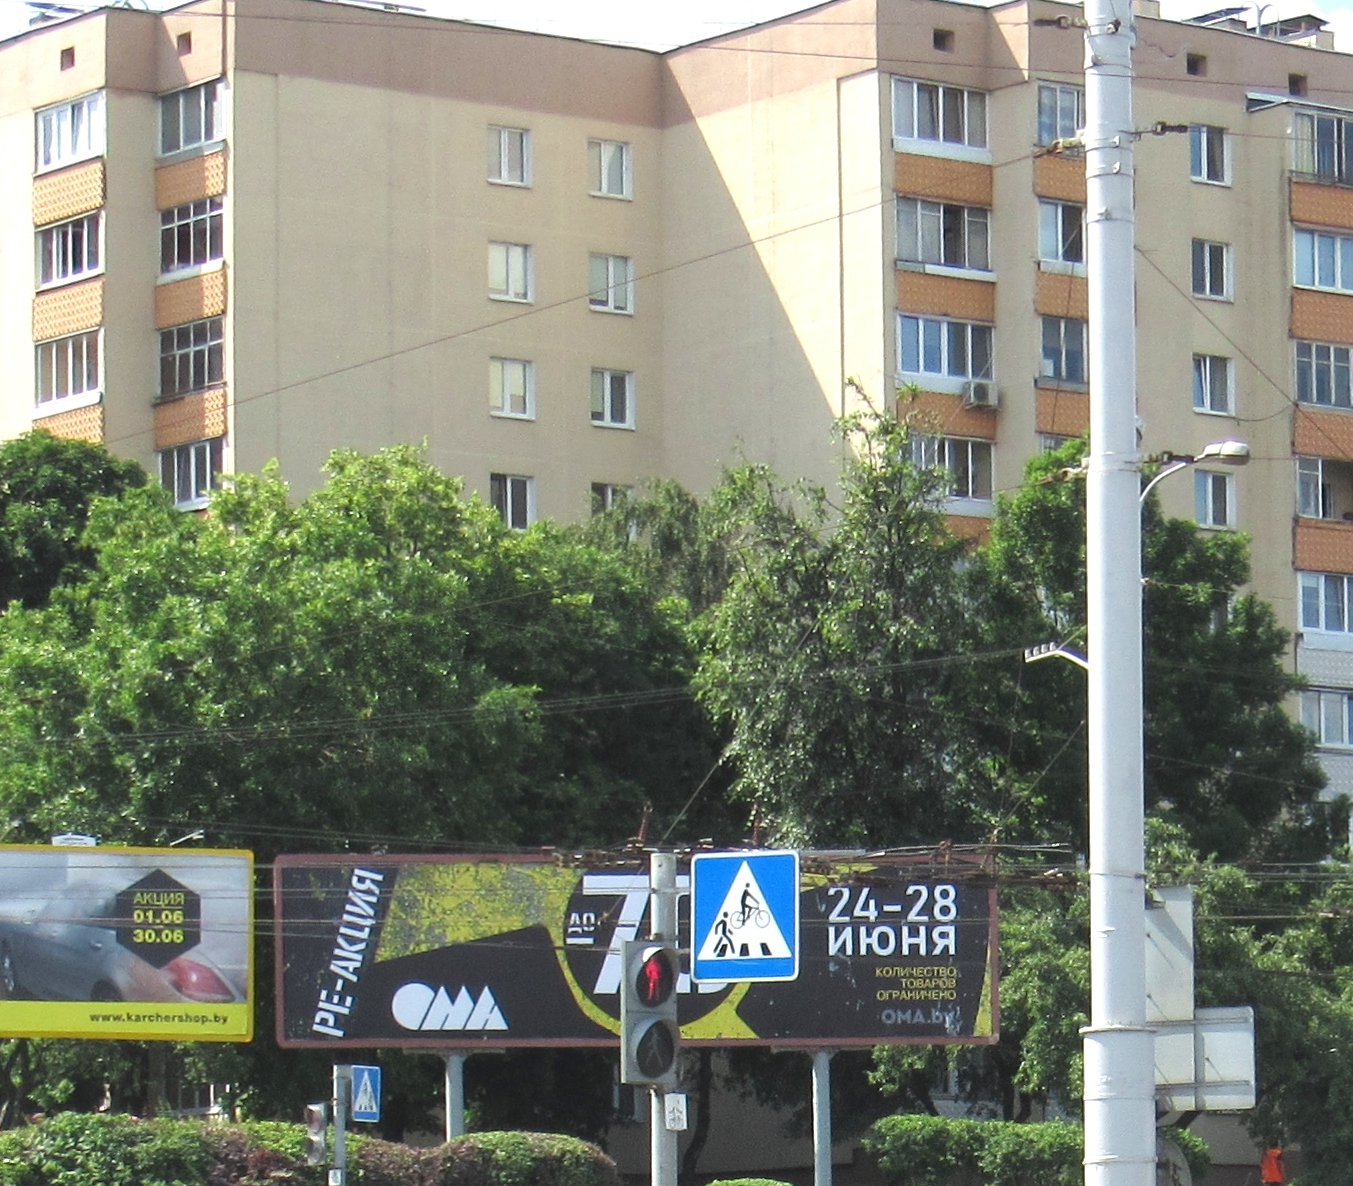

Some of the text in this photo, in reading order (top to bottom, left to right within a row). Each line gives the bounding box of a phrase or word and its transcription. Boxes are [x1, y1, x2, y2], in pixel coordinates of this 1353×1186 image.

[133, 893, 184, 906] АКЦИЯ
[827, 884, 957, 923] 24-28
[133, 910, 184, 923] 01.06
[133, 929, 184, 943] 30.06
[828, 925, 956, 956] ИЮНЯ
[312, 868, 384, 1038] РЕ-АКЦИЯ
[875, 966, 957, 978] КОЛИЧЕСТВО
[900, 978, 957, 988] ТОВАРОВ
[876, 989, 957, 1000] ОГРАНИЧЕНО
[89, 1013, 228, 1025] www.karchershop.by
